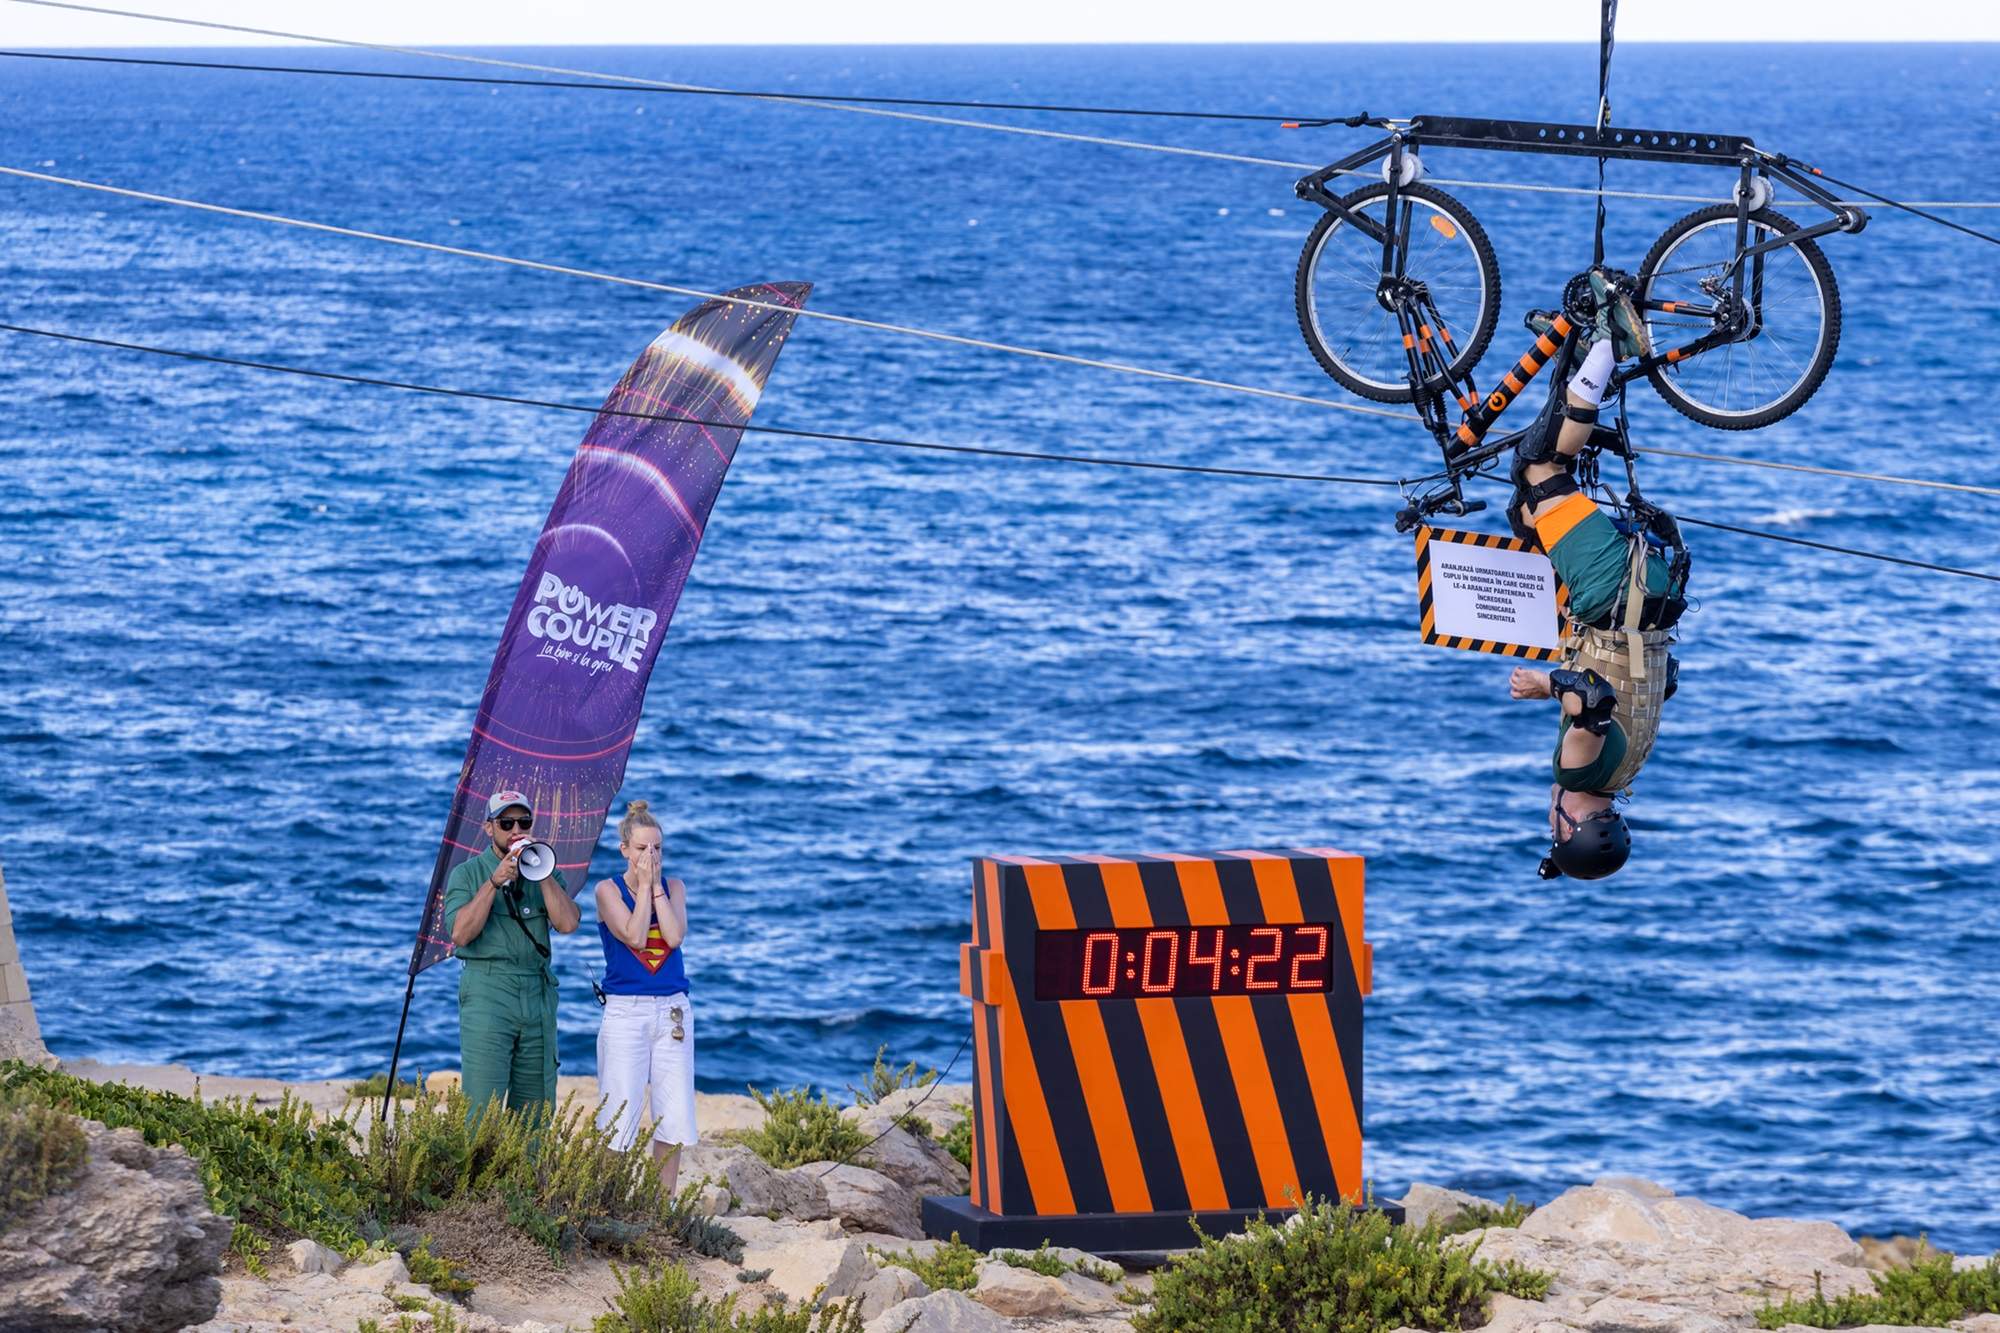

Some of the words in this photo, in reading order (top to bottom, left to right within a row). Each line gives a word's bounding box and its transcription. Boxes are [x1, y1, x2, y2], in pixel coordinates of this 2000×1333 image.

[1443, 572, 1461, 580] CUPLU
[1462, 573, 1469, 581] ÎN
[1470, 576, 1494, 585] ORDINEA
[1496, 578, 1502, 586] ÎN
[1518, 582, 1535, 590] CREZI
[1516, 573, 1536, 581] VALORI
[1453, 582, 1466, 590] LE-A
[1467, 584, 1492, 593] ARANJAT
[1494, 587, 1526, 598] PARTENERA
[534, 571, 657, 643] POWER
[1477, 594, 1512, 604] ÎNCREDEREA
[1475, 603, 1516, 613] COMUNICAREA
[1476, 613, 1516, 623] SINCERITATEA
[527, 605, 647, 673] COUPLE
[554, 642, 573, 660] bine
[580, 651, 591, 667] la
[589, 659, 613, 676] greu
[1082, 926, 1327, 994] 0:04:22
